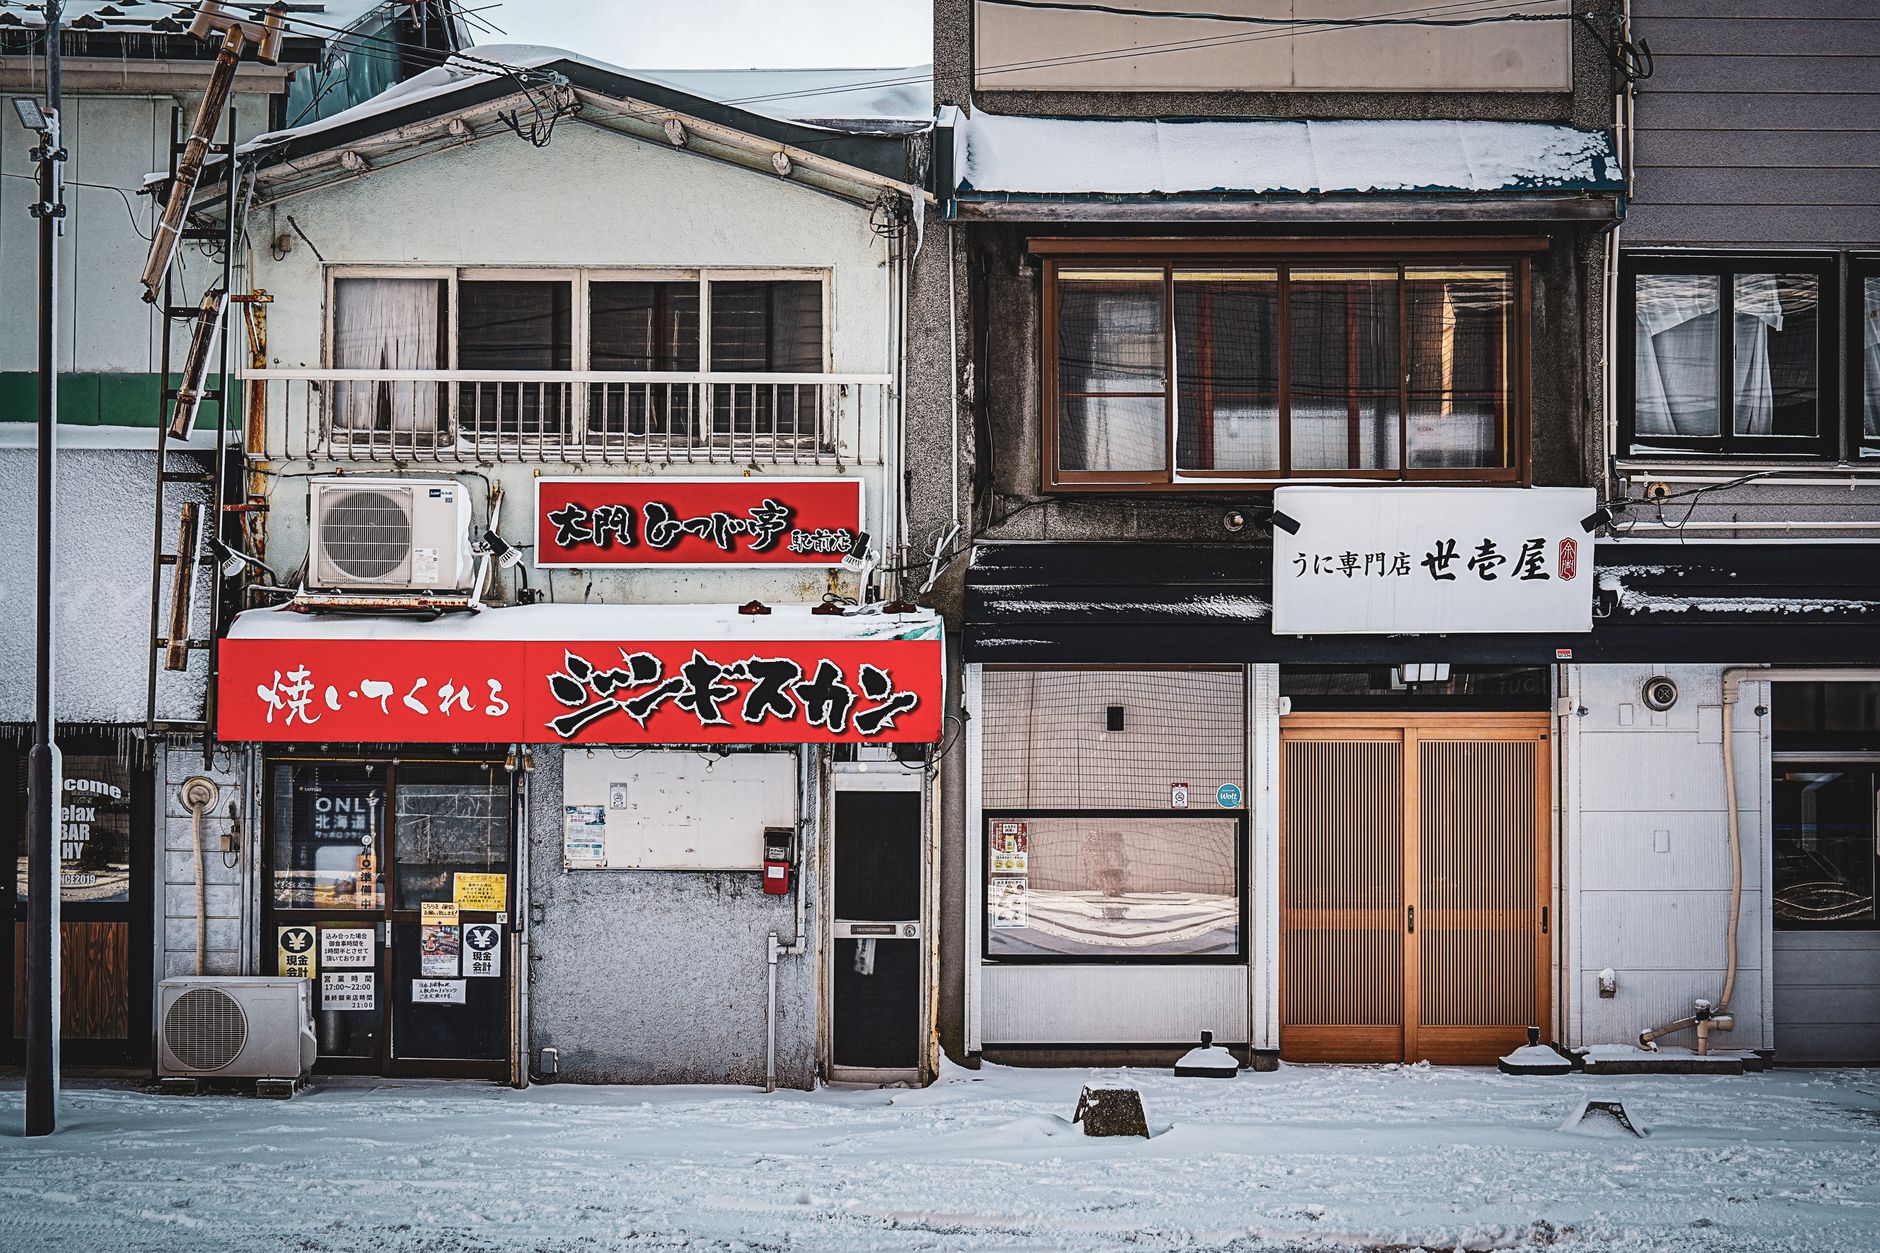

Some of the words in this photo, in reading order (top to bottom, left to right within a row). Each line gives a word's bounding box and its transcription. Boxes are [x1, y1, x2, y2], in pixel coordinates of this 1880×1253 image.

[788, 530, 852, 553] 駅前店
[1292, 551, 1411, 578] うに専門店
[1420, 538, 1551, 581] 世壱屋
[256, 664, 510, 726] 焼いてくれる
[545, 647, 919, 738] ジンギスカン
[60, 778, 122, 799] come
[1220, 792, 1238, 800] Wolt
[60, 804, 96, 822] elax
[315, 814, 366, 830] 北海道
[360, 870, 372, 910] 準備中
[286, 954, 309, 966] 現金
[472, 951, 492, 961] 現金
[286, 967, 309, 977] 会計
[472, 961, 492, 972] 会計
[323, 975, 373, 983] 営業時間
